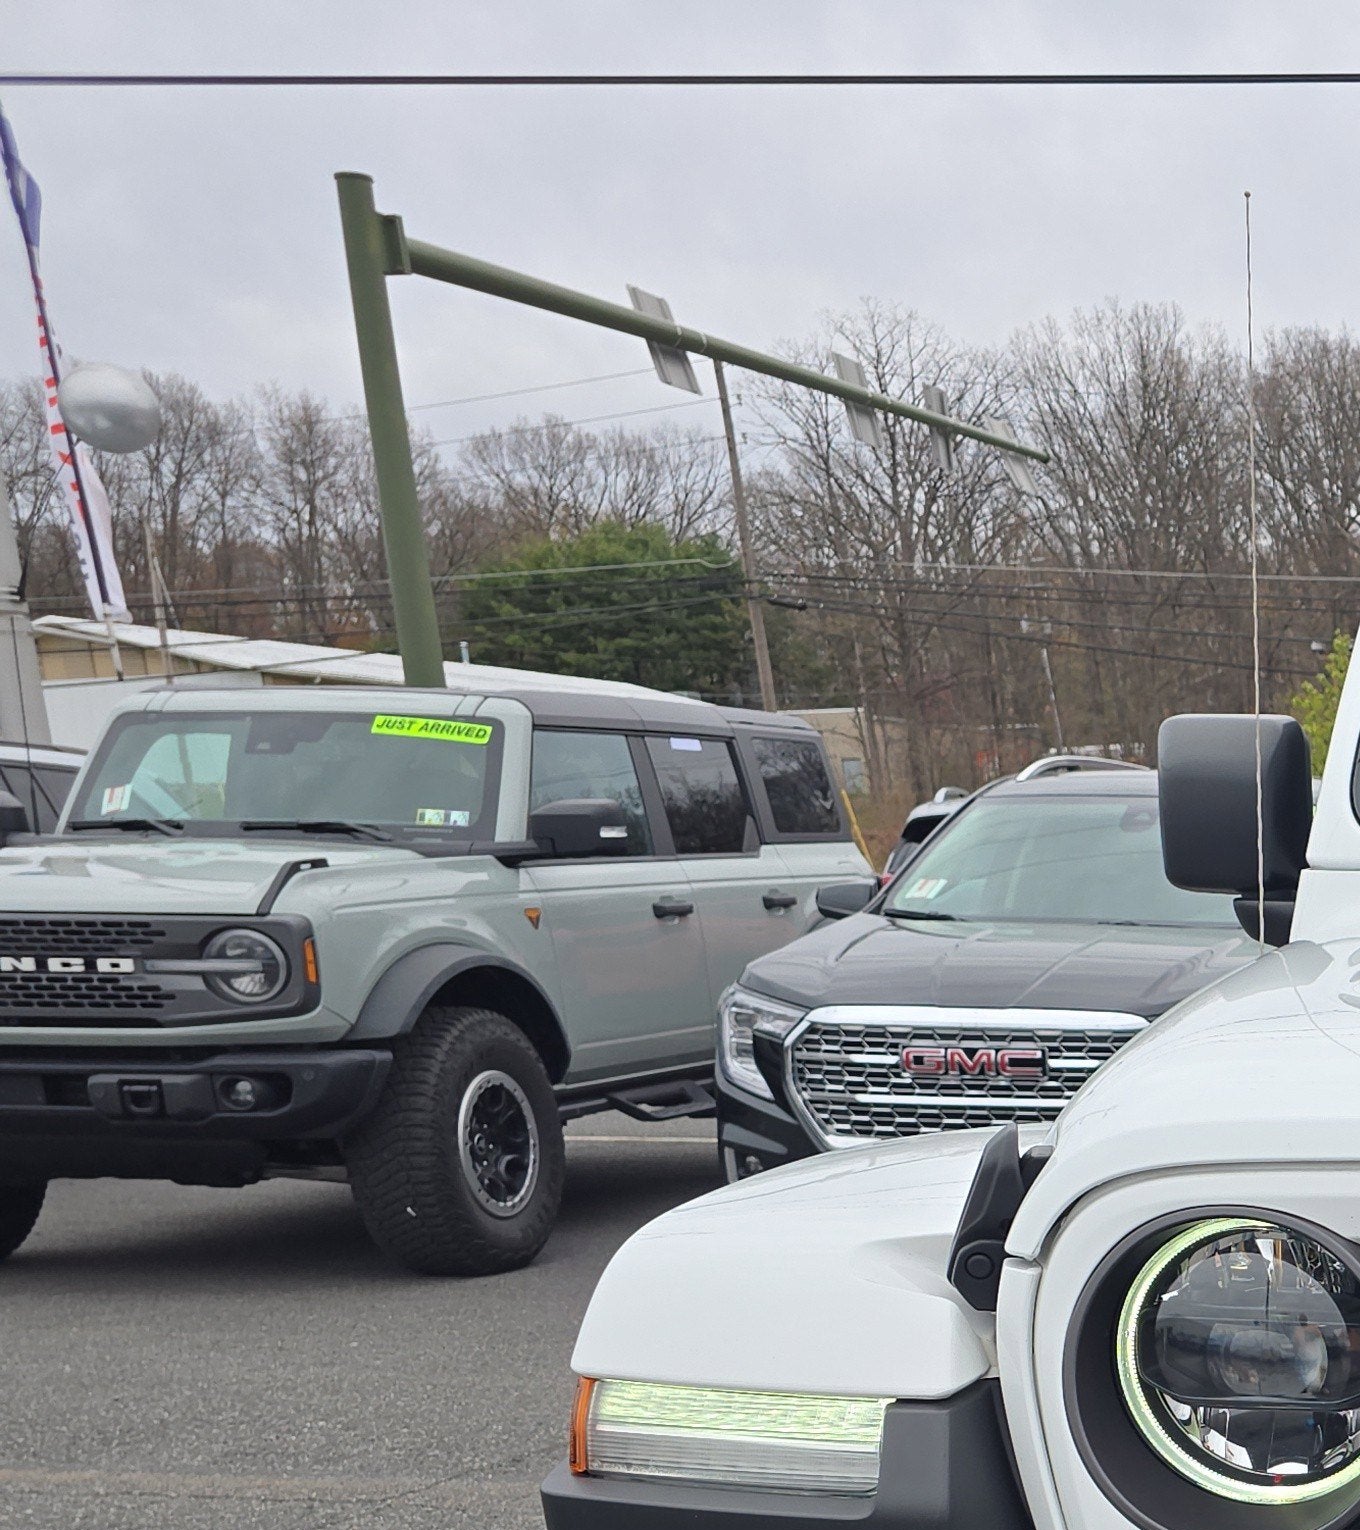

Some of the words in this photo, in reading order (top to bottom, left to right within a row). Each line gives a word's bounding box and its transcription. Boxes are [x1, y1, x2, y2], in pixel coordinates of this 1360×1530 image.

[376, 718, 417, 731] JUST
[418, 722, 488, 739] ARRIVED
[901, 1046, 1046, 1077] GMC
